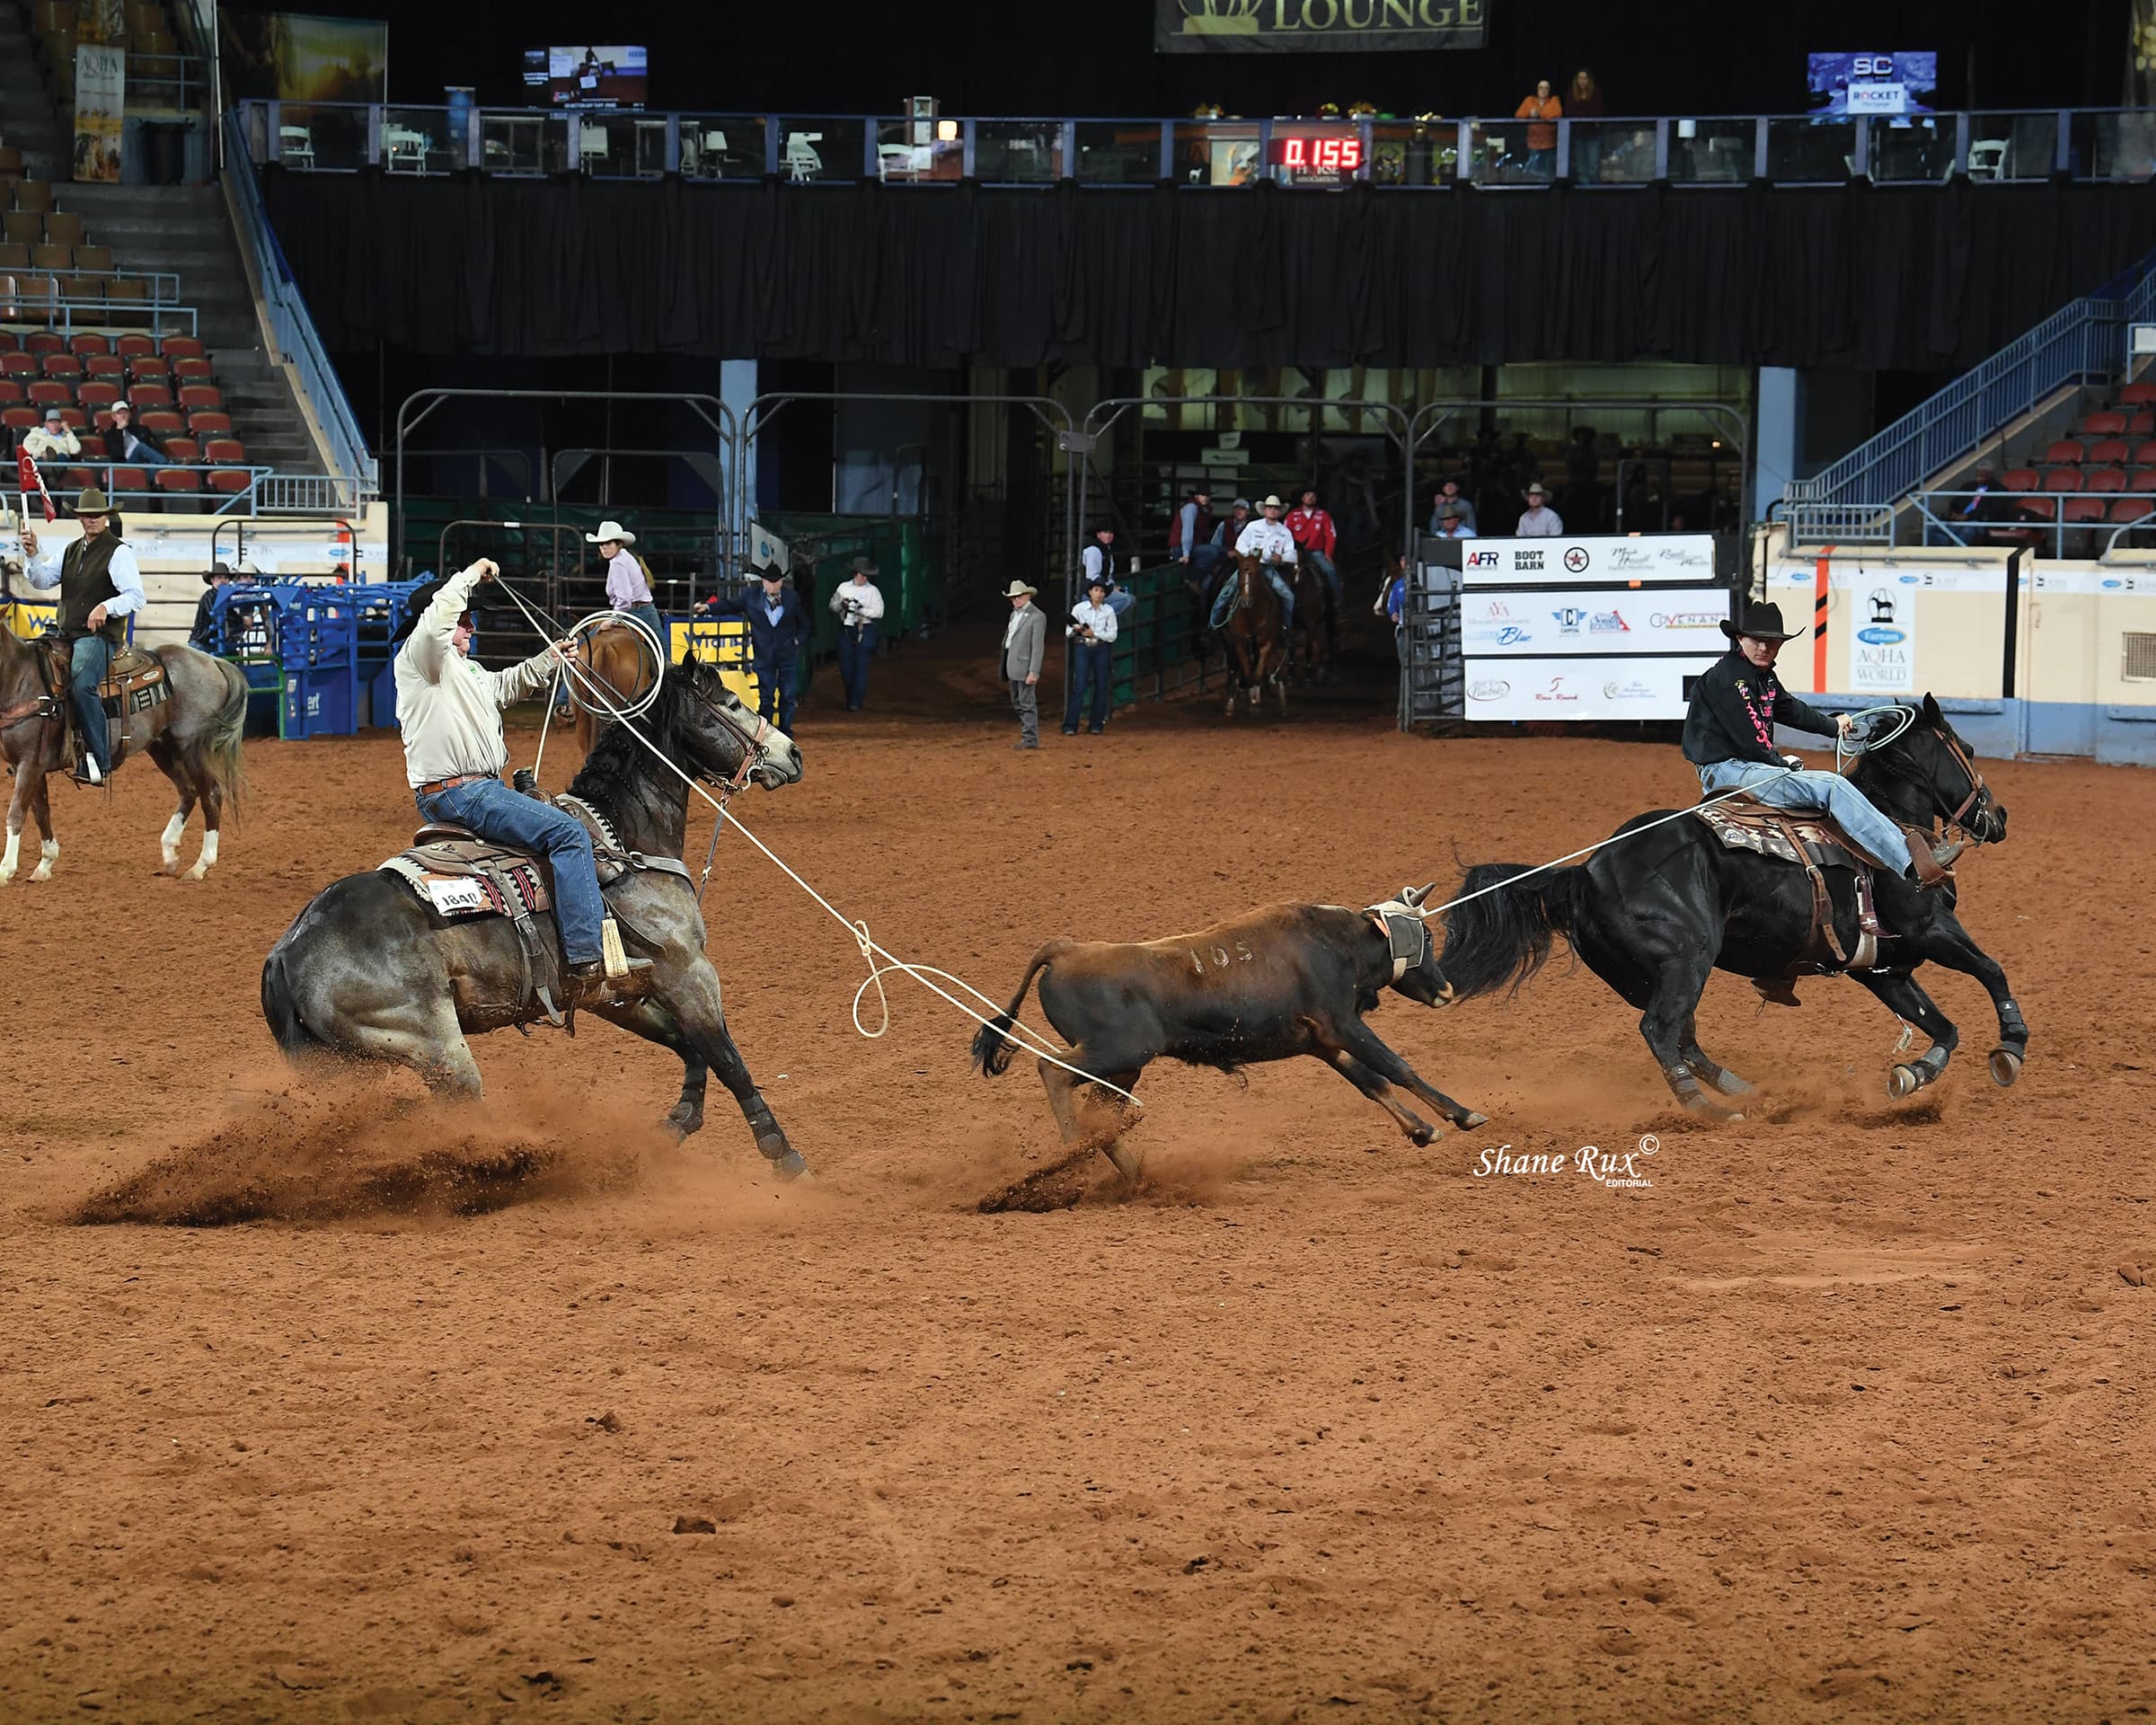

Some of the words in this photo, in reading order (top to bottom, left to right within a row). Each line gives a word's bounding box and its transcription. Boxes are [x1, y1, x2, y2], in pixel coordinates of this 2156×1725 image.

[1272, 0, 1483, 30] LOUNGE
[1853, 57, 1893, 75] SC
[1853, 91, 1898, 101] ROCKET
[1467, 552, 1499, 565] AFR
[1515, 551, 1544, 561] BOOT
[1515, 562, 1544, 571] BARN
[1857, 649, 1905, 667] AQHA
[1857, 668, 1906, 681] WORLD
